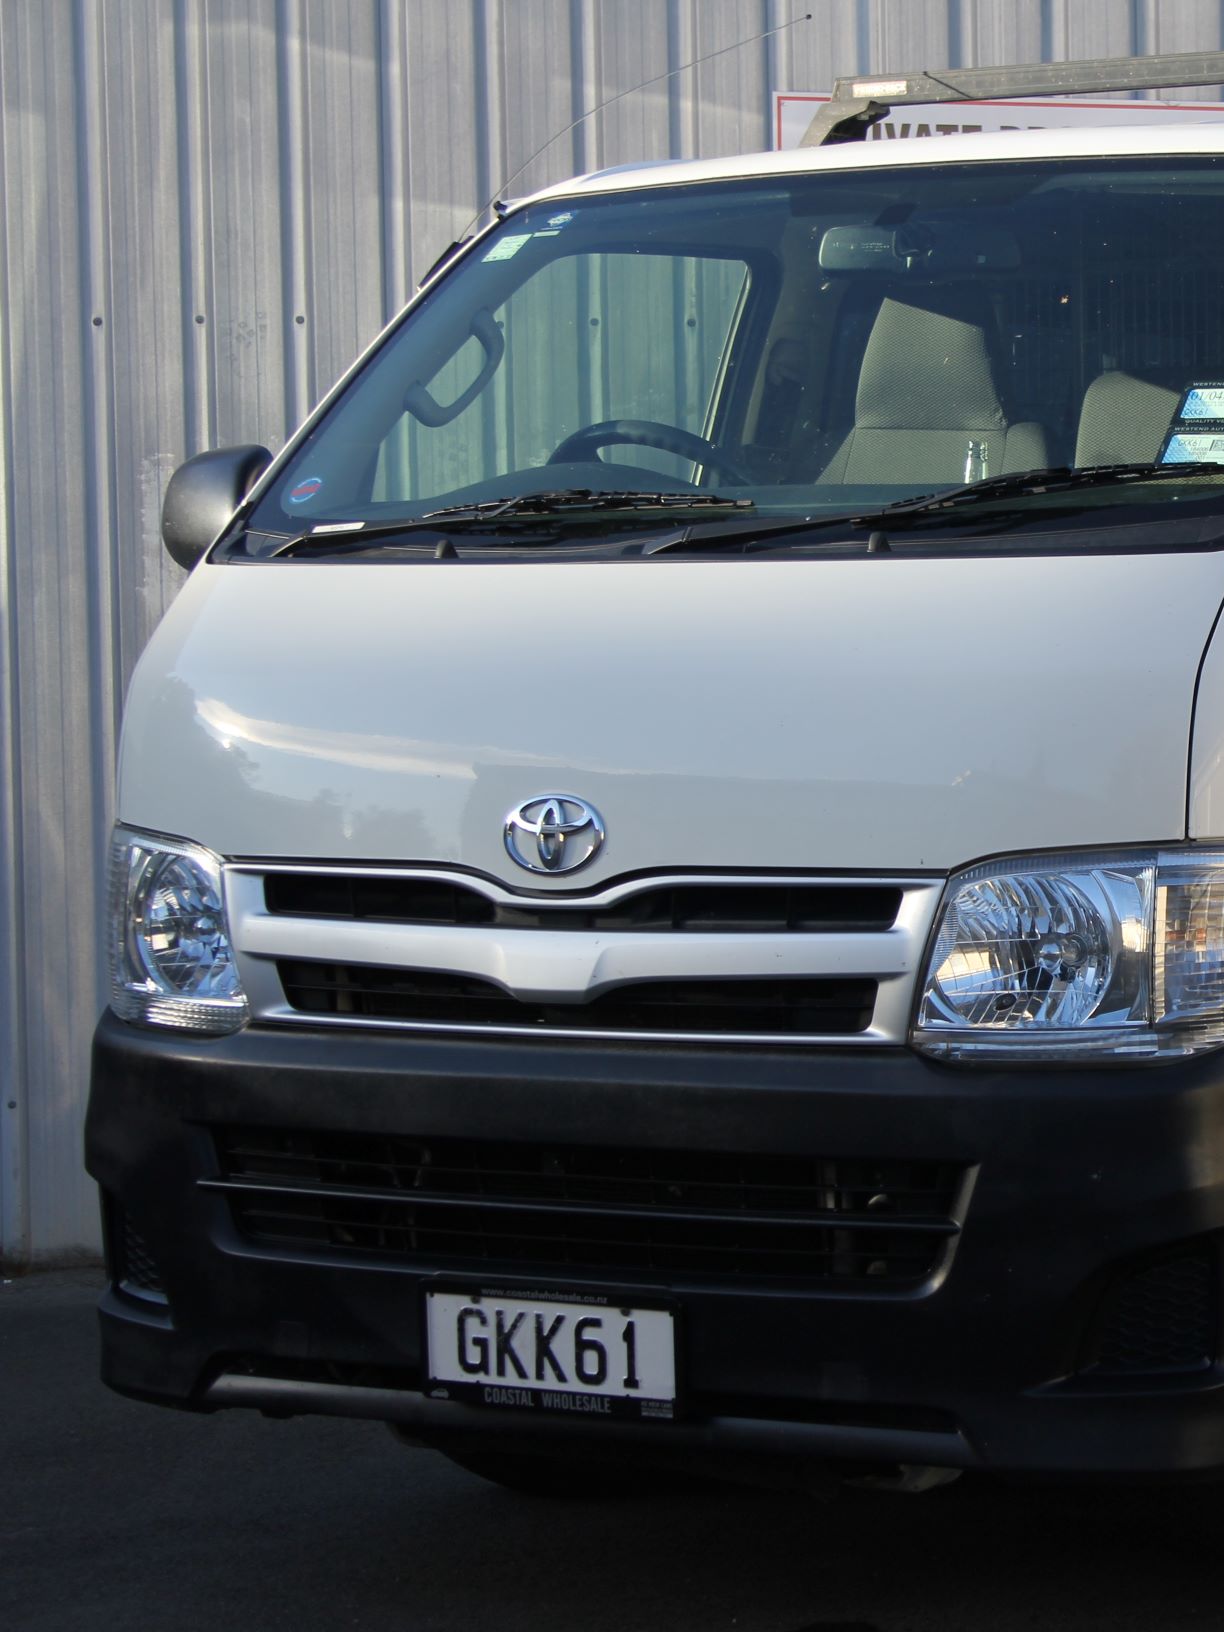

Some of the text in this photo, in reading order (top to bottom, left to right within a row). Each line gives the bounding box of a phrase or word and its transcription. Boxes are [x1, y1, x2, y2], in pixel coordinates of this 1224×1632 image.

[481, 1287, 608, 1304] www.coastalwholesale.co.nz
[457, 1305, 640, 1389] GKK61
[484, 1387, 611, 1413] COASTAL WHOLESALE
